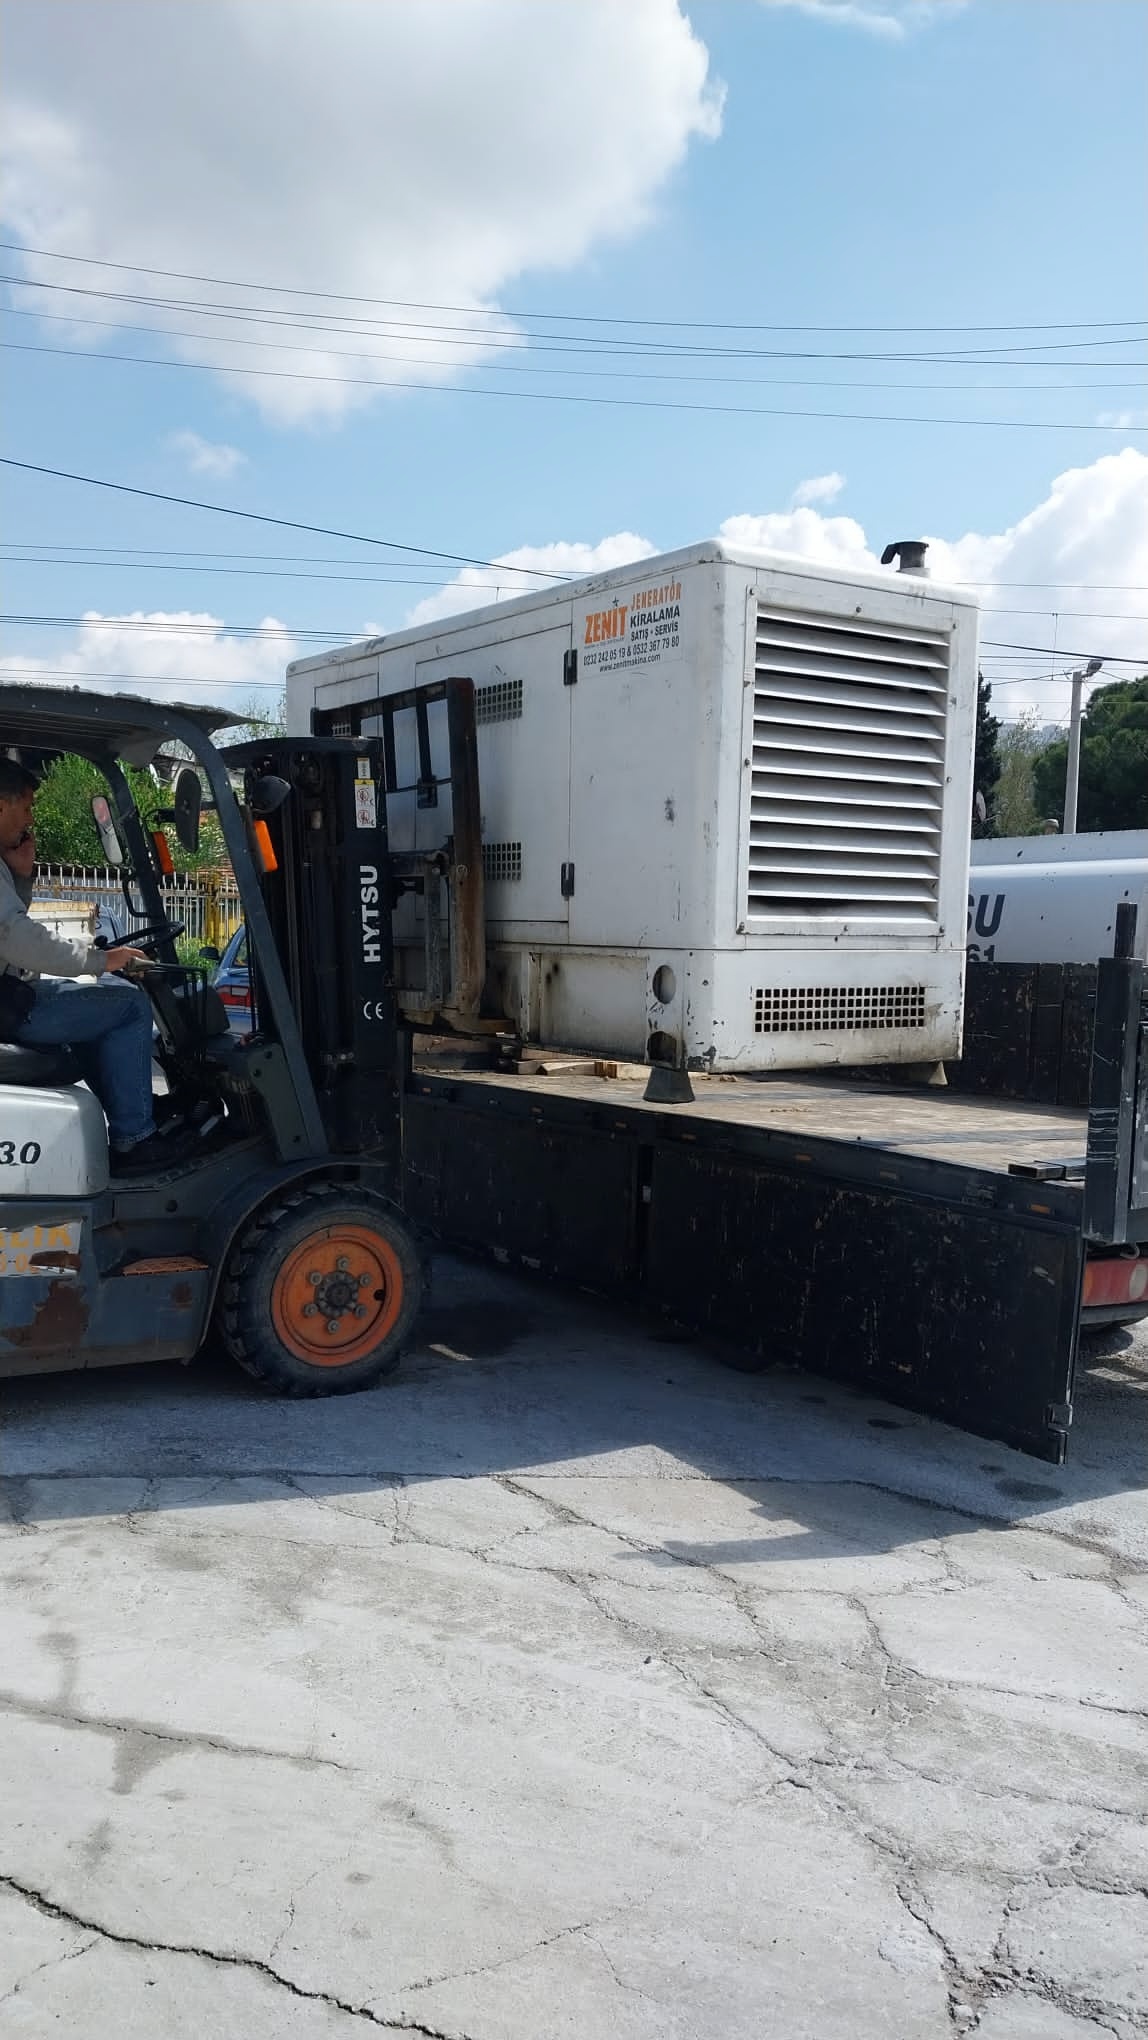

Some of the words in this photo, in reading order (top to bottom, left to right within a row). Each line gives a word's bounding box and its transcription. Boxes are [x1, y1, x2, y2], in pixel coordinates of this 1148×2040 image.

[630, 604, 680, 628] KİRALAMA
[631, 628, 649, 642] SATIŞ
[654, 621, 679, 637] SERVİS
[609, 649, 617, 661] 05
[360, 865, 381, 963] HYTSU
